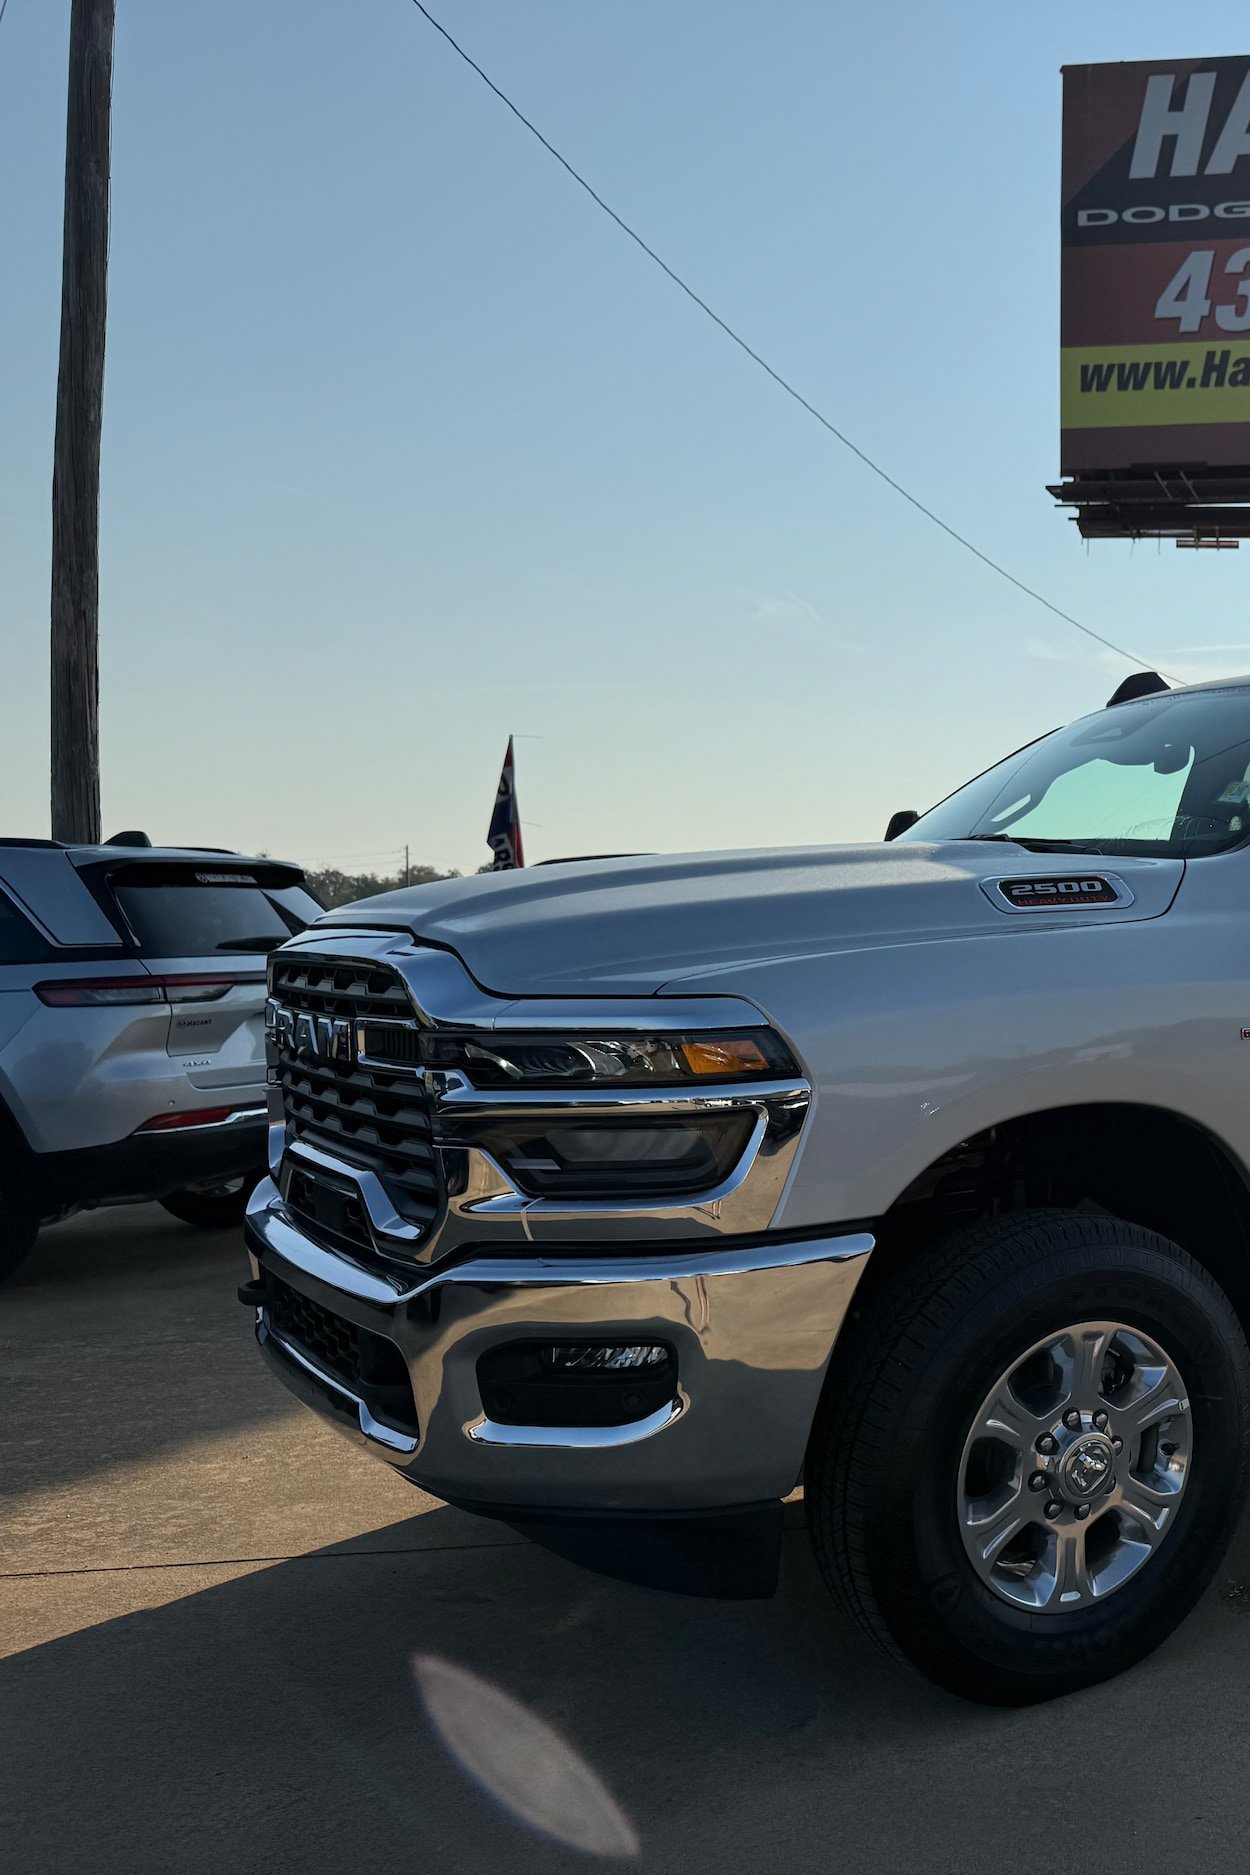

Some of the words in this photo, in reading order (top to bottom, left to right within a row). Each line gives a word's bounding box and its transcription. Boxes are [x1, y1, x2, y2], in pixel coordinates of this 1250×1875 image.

[1008, 880, 1103, 896] 2500
[1017, 897, 1067, 906] HEAVY
[276, 1008, 351, 1062] RAM
